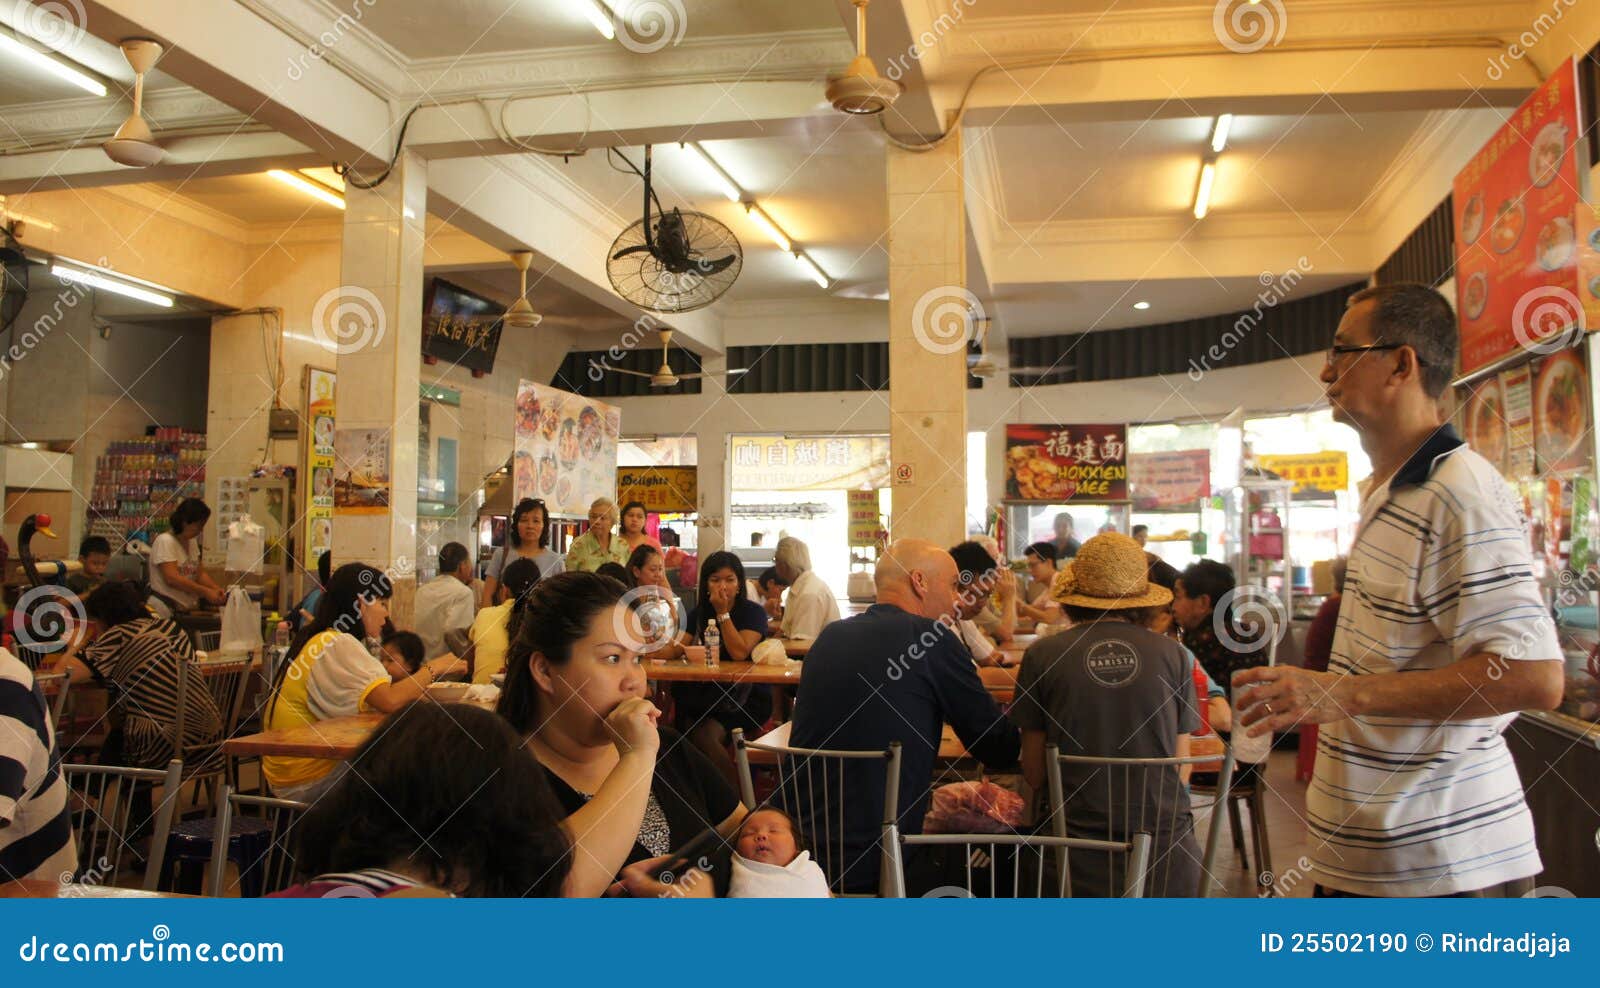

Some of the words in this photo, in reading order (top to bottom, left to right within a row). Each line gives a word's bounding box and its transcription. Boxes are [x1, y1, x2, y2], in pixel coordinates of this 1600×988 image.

[1043, 431, 1124, 465] 福建面
[1057, 465, 1127, 481] HOKKIEN
[1074, 480, 1110, 496] MEE
[1090, 657, 1136, 668] BARISTA
